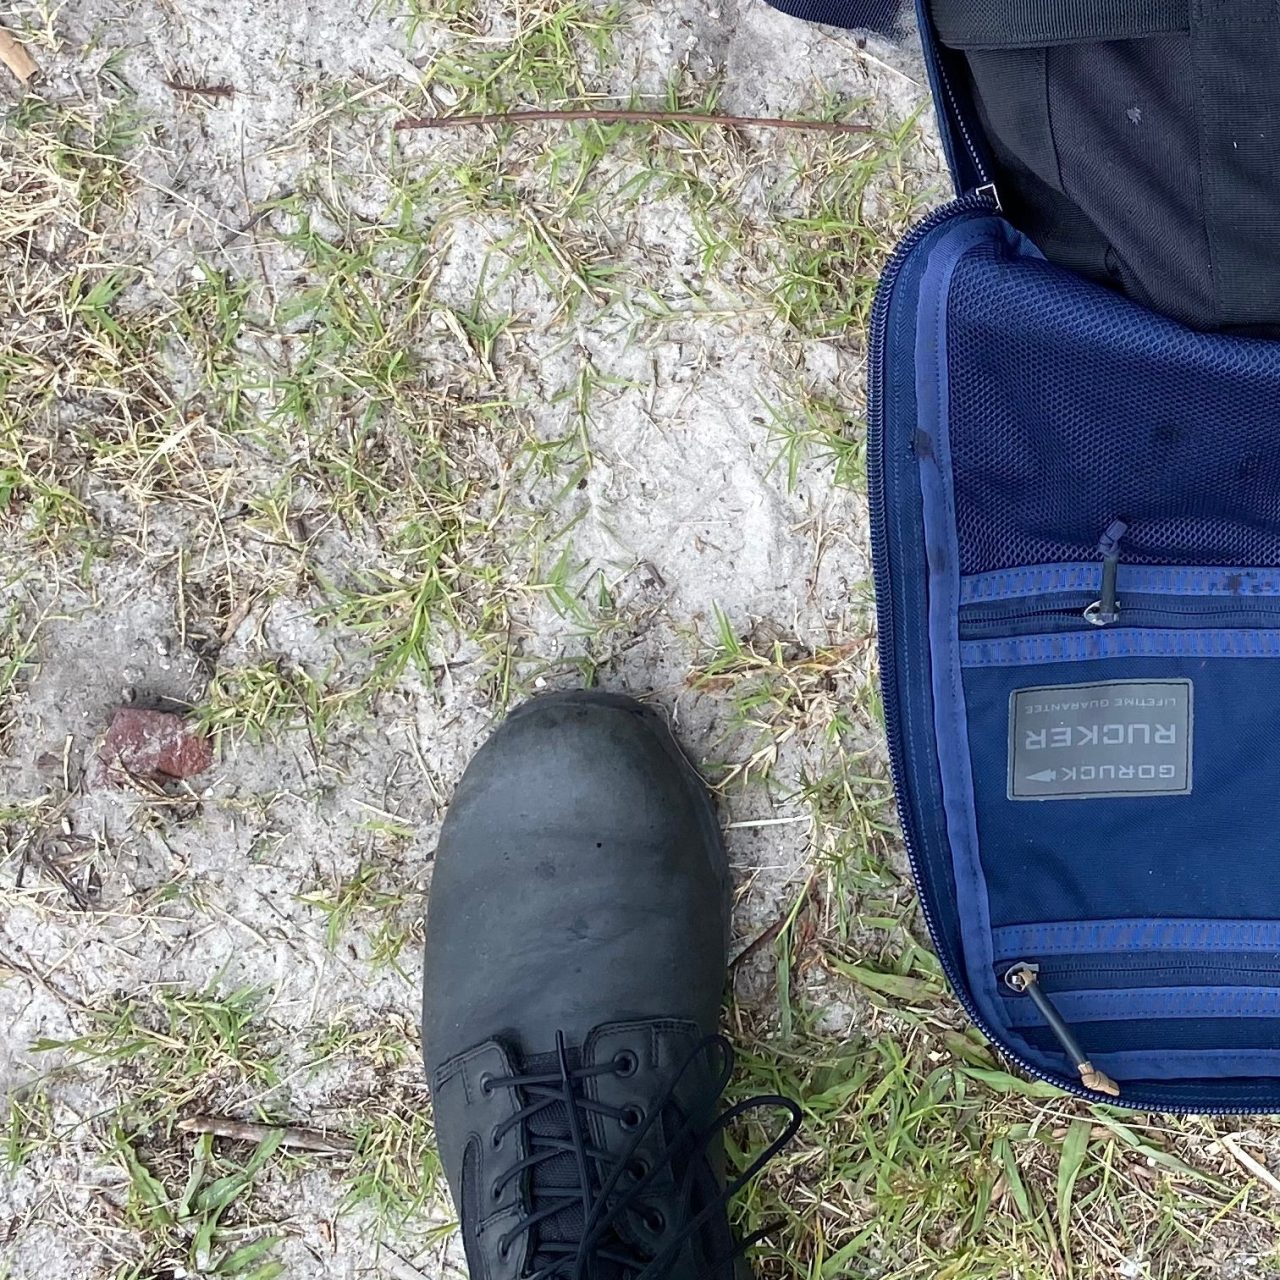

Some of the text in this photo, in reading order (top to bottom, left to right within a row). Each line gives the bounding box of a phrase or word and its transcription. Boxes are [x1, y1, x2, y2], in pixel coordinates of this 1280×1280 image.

[1025, 697, 1177, 714] LIFETIME GUARANTEE
[1025, 723, 1177, 751] RUCKER
[1061, 764, 1176, 782] GORUCK
